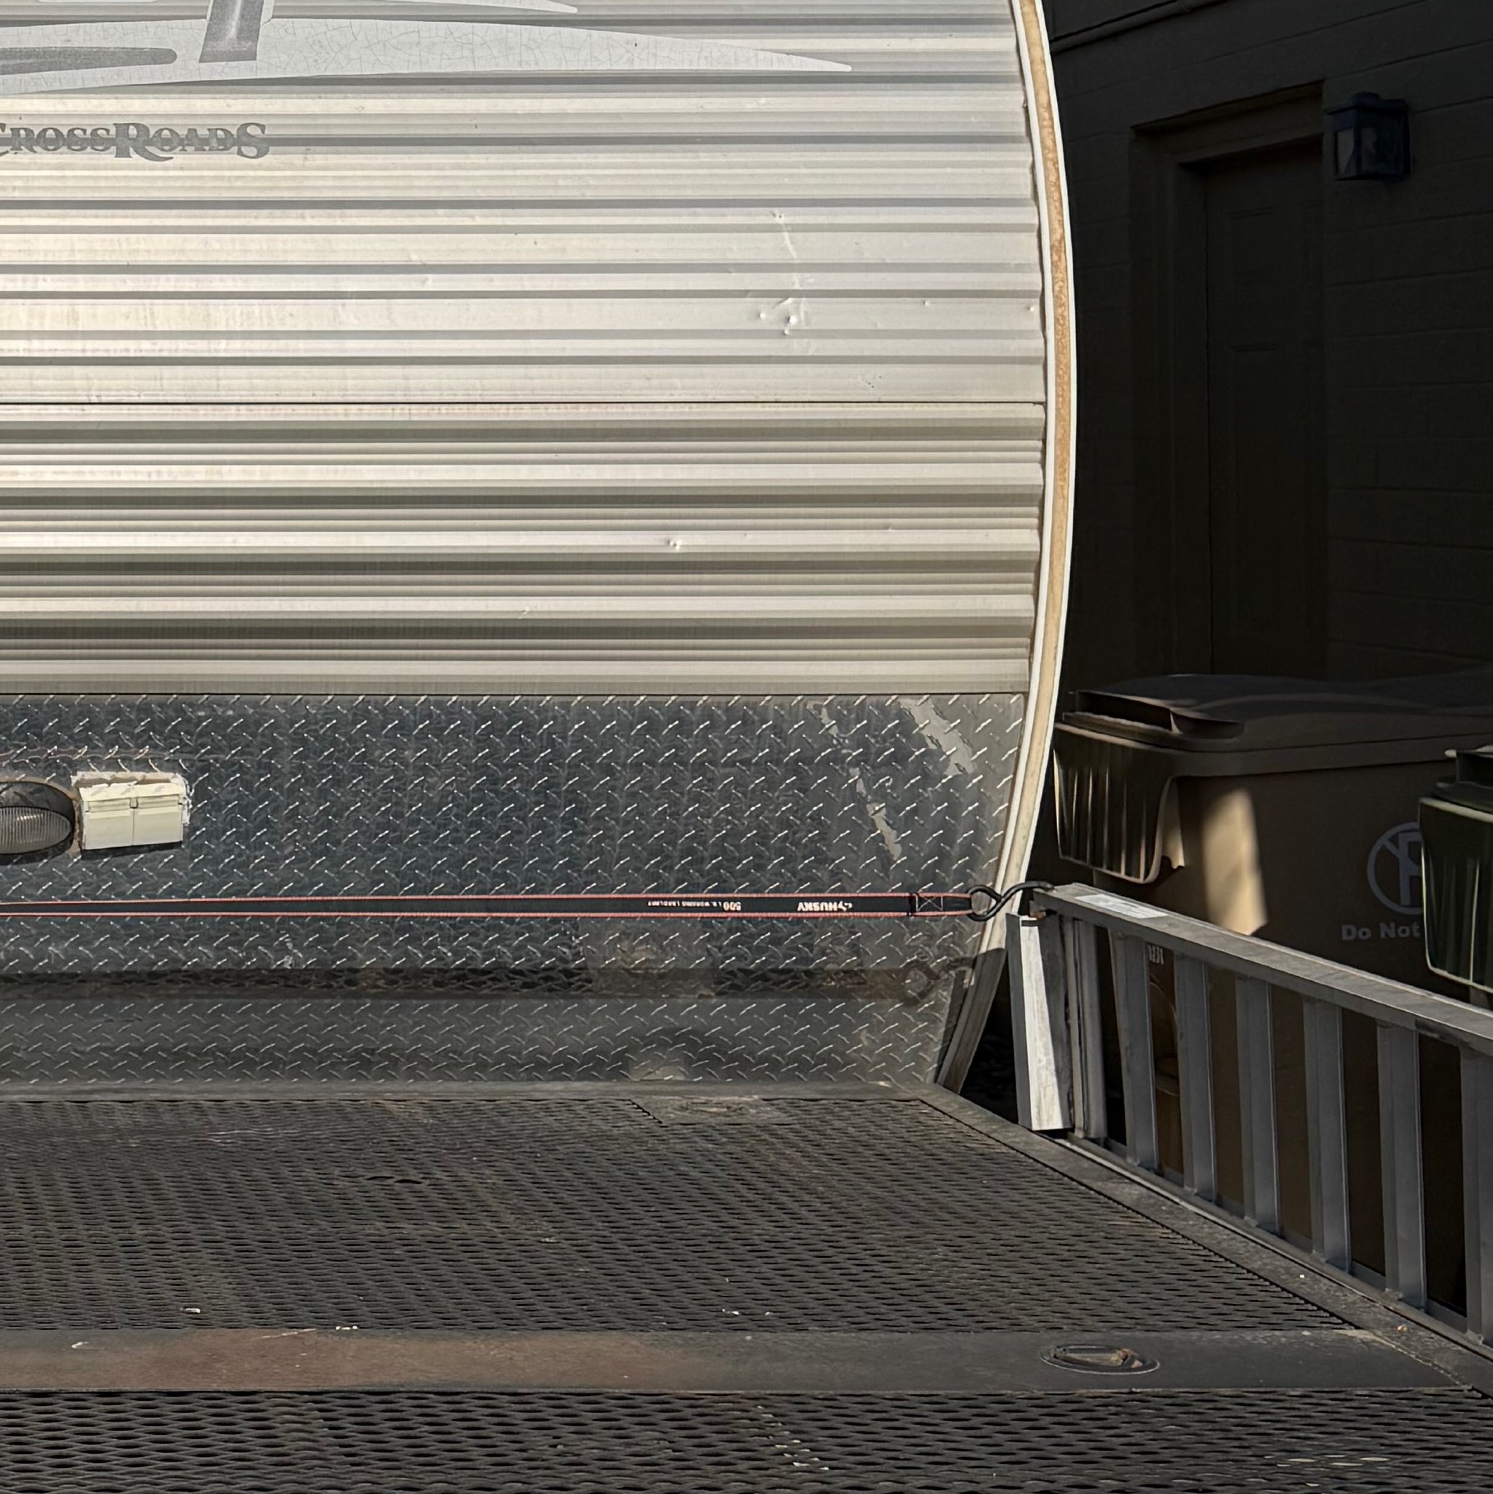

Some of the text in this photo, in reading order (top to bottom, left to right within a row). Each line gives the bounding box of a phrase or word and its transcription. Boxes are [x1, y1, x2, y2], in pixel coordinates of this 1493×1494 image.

[797, 901, 838, 912] HUSKY
[1341, 921, 1421, 941] Do Not
